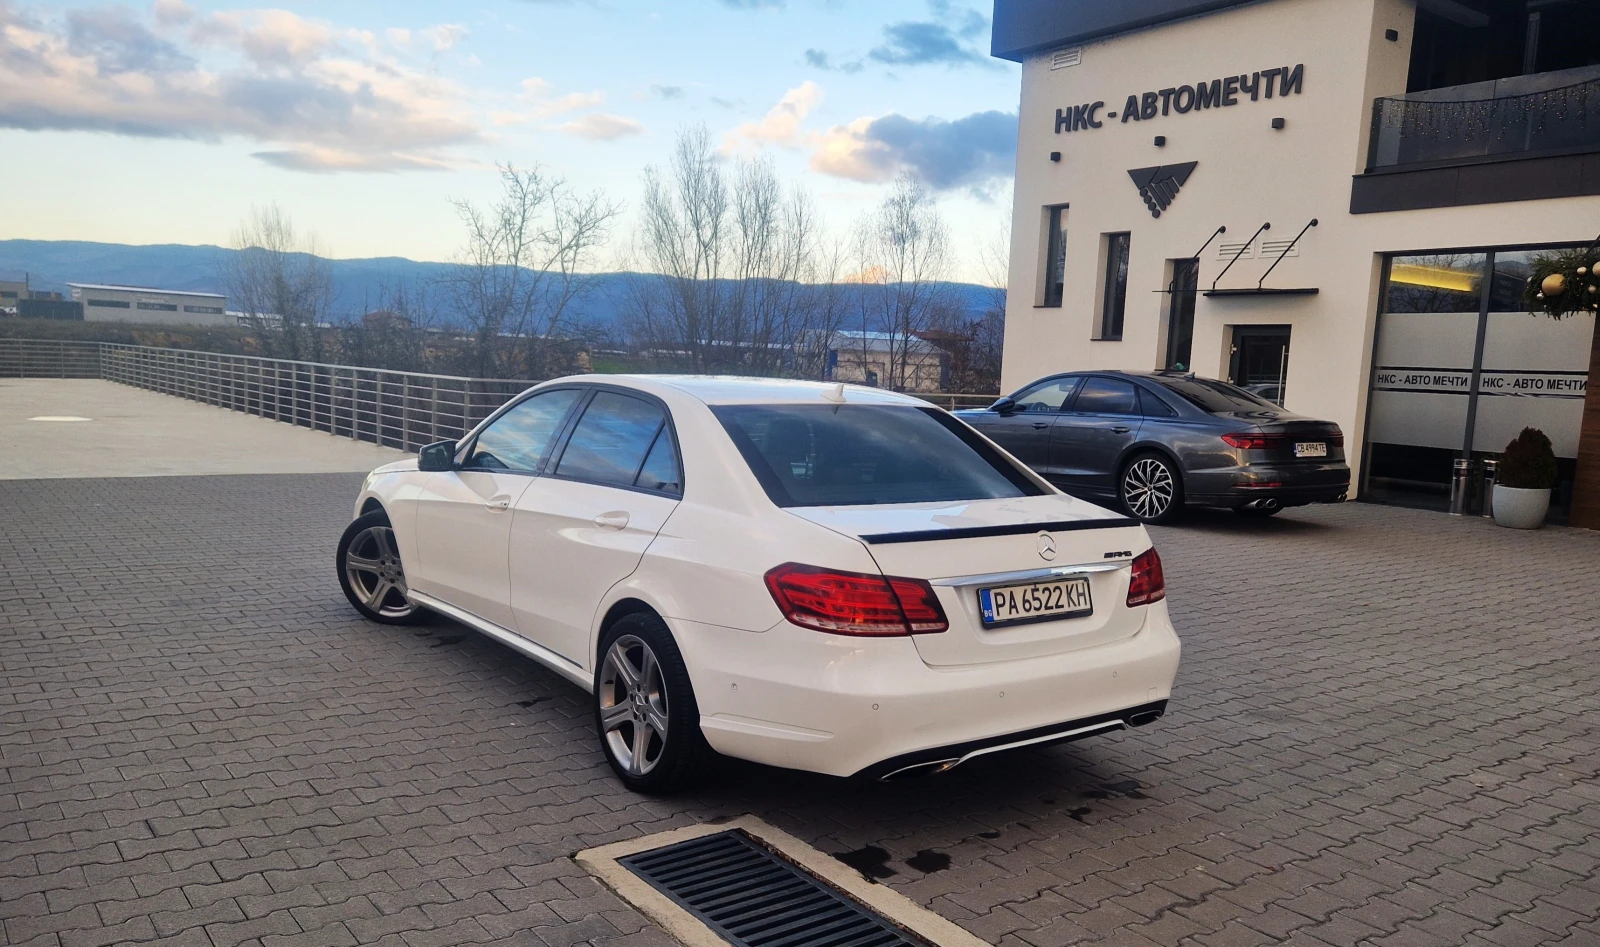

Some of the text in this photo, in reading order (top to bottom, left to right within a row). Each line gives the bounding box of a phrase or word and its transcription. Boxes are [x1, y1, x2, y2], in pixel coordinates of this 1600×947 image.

[1054, 101, 1104, 134] НКС
[1121, 63, 1304, 123] АВТОМЕЧТИ
[1377, 374, 1396, 384] НКС
[1404, 375, 1431, 385] АВТО
[1432, 376, 1468, 387] МЕЧТИ
[1482, 377, 1504, 388] НКС
[1513, 378, 1544, 390] АВТО
[1546, 379, 1588, 391] МЕЧТИ
[984, 609, 993, 618] BG
